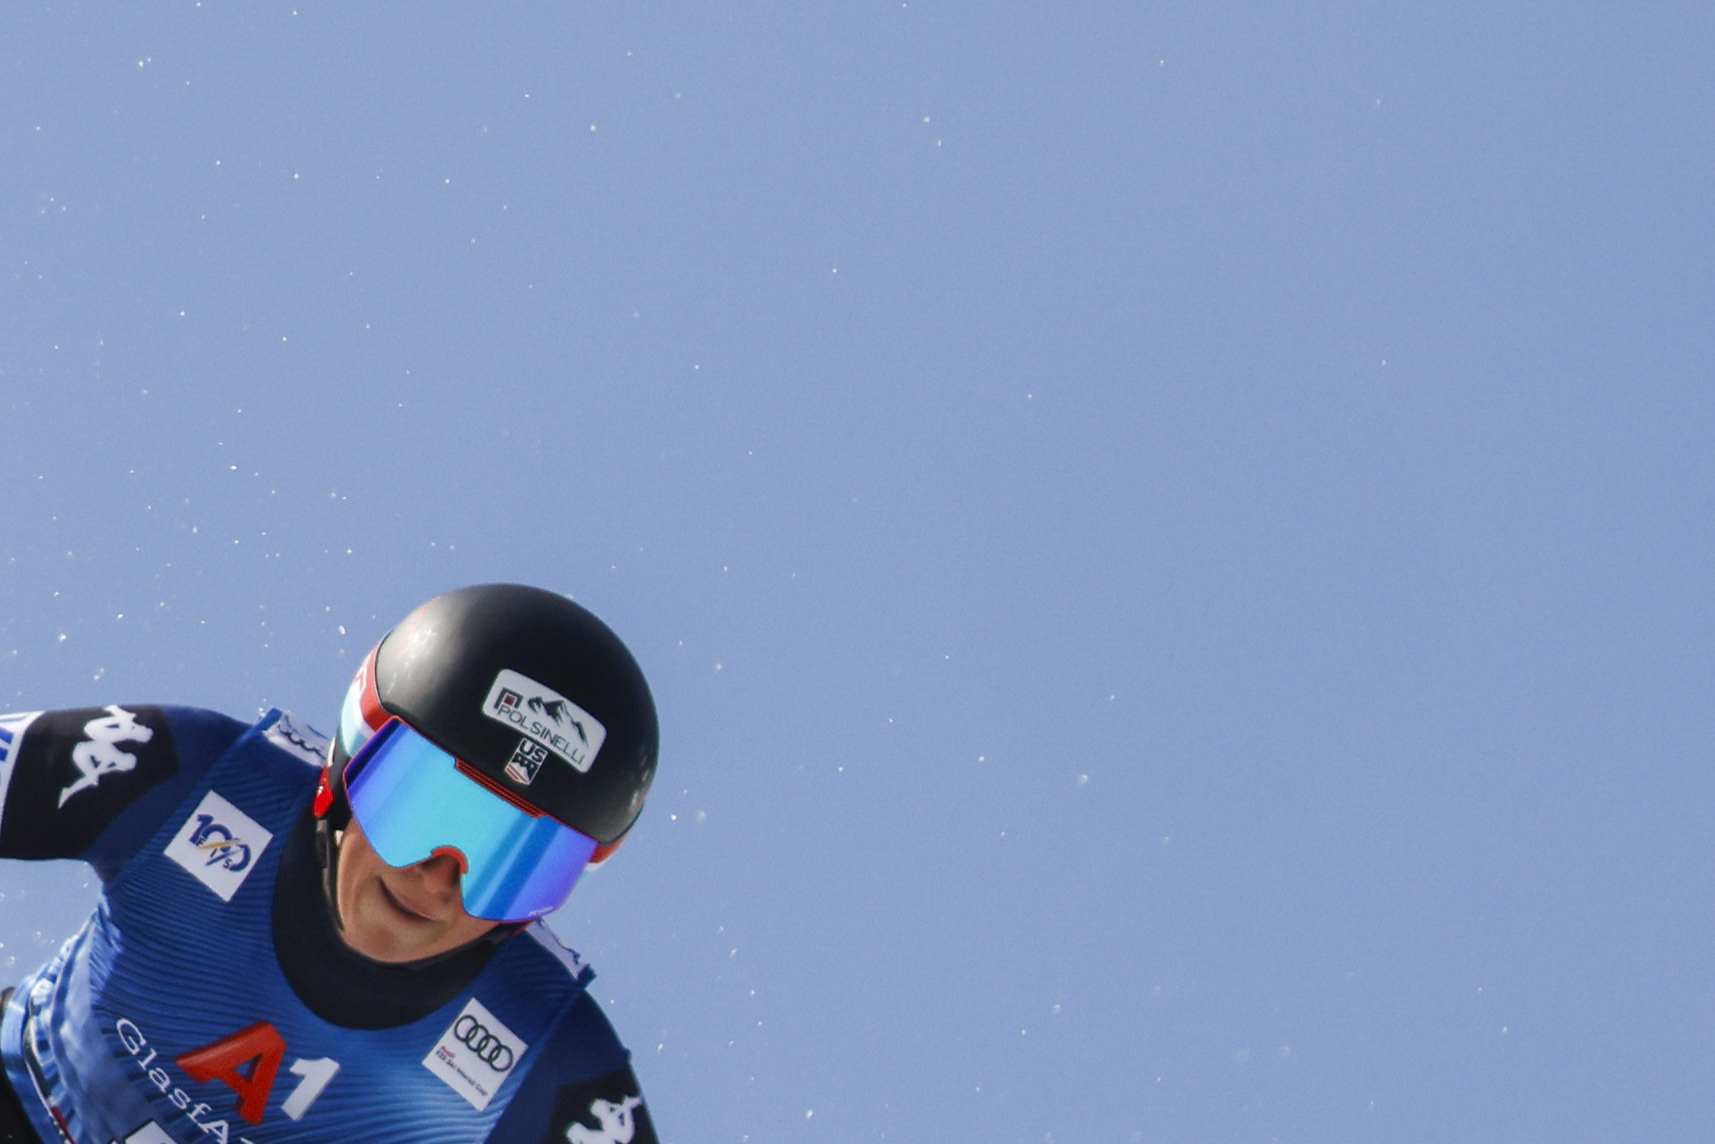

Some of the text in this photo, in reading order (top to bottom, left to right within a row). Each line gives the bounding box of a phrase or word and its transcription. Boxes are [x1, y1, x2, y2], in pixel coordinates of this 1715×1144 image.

[497, 705, 586, 765] POLSINELLI
[519, 739, 545, 763] US
[174, 1020, 341, 1127] A1
